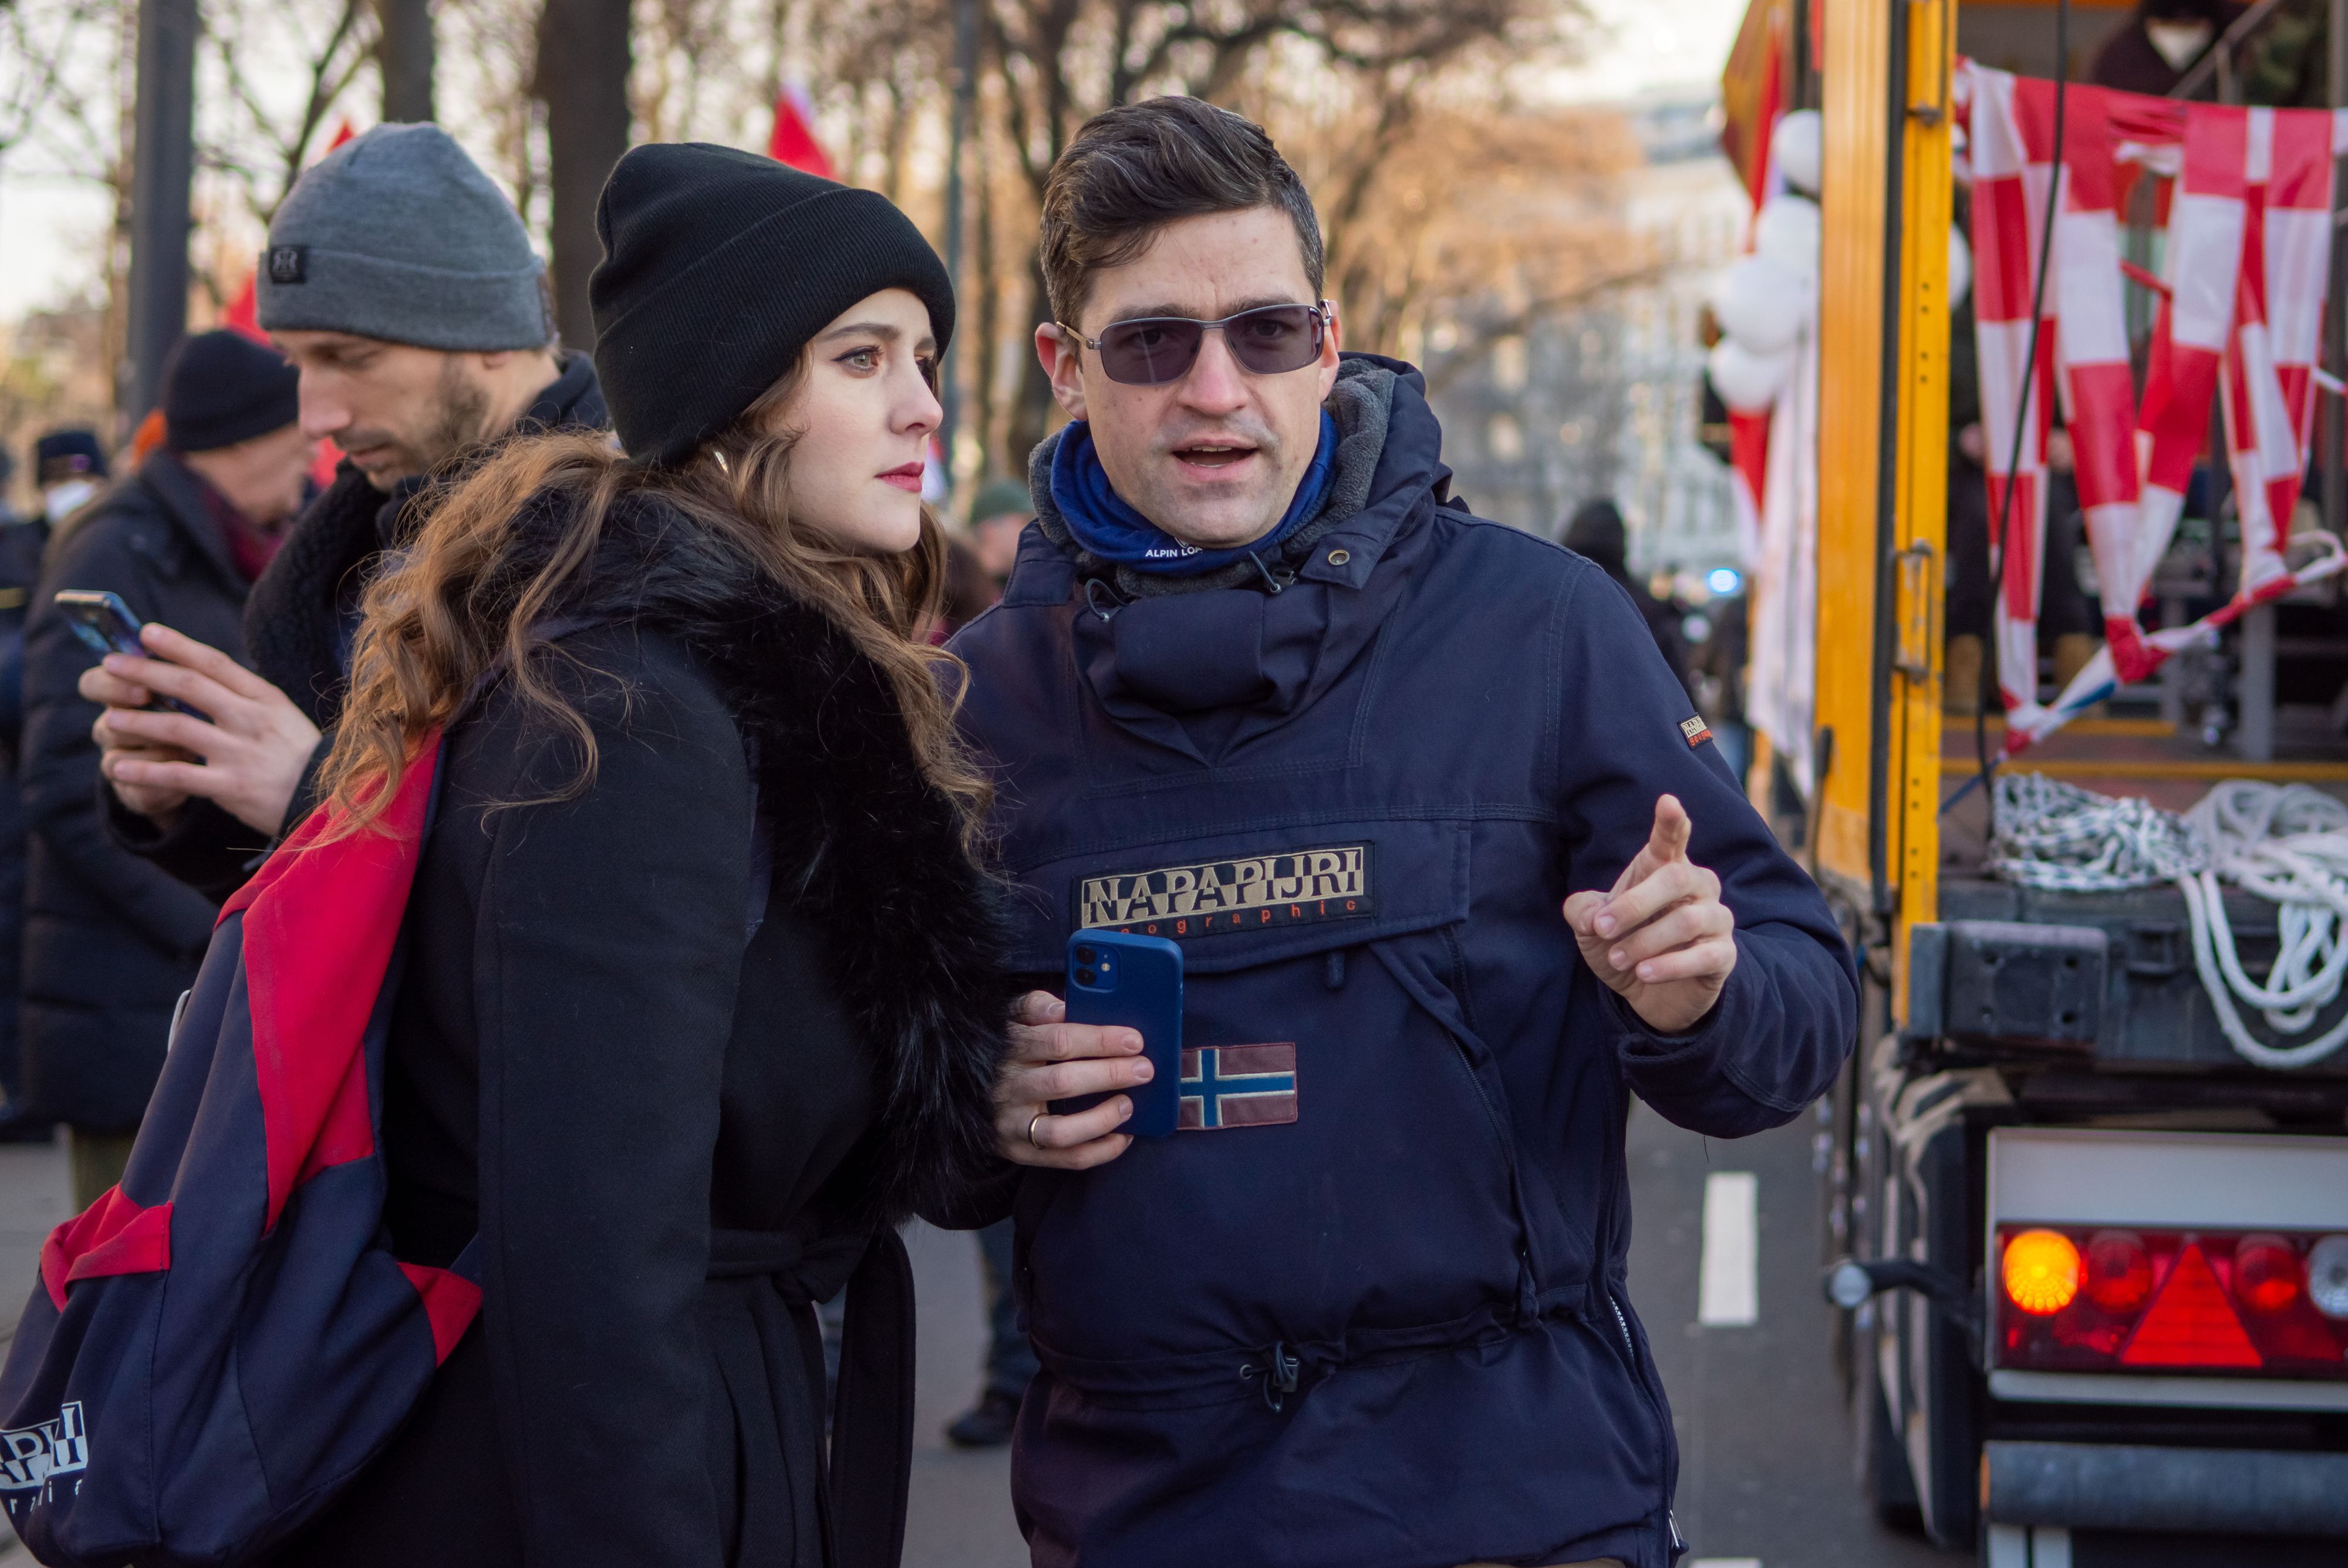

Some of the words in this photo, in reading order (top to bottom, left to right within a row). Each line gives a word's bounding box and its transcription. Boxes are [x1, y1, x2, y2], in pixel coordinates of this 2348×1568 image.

[1145, 549, 1178, 558] ALPIN
[1086, 851, 1359, 924] NAPAPIJRI
[1120, 899, 1357, 935] eographic
